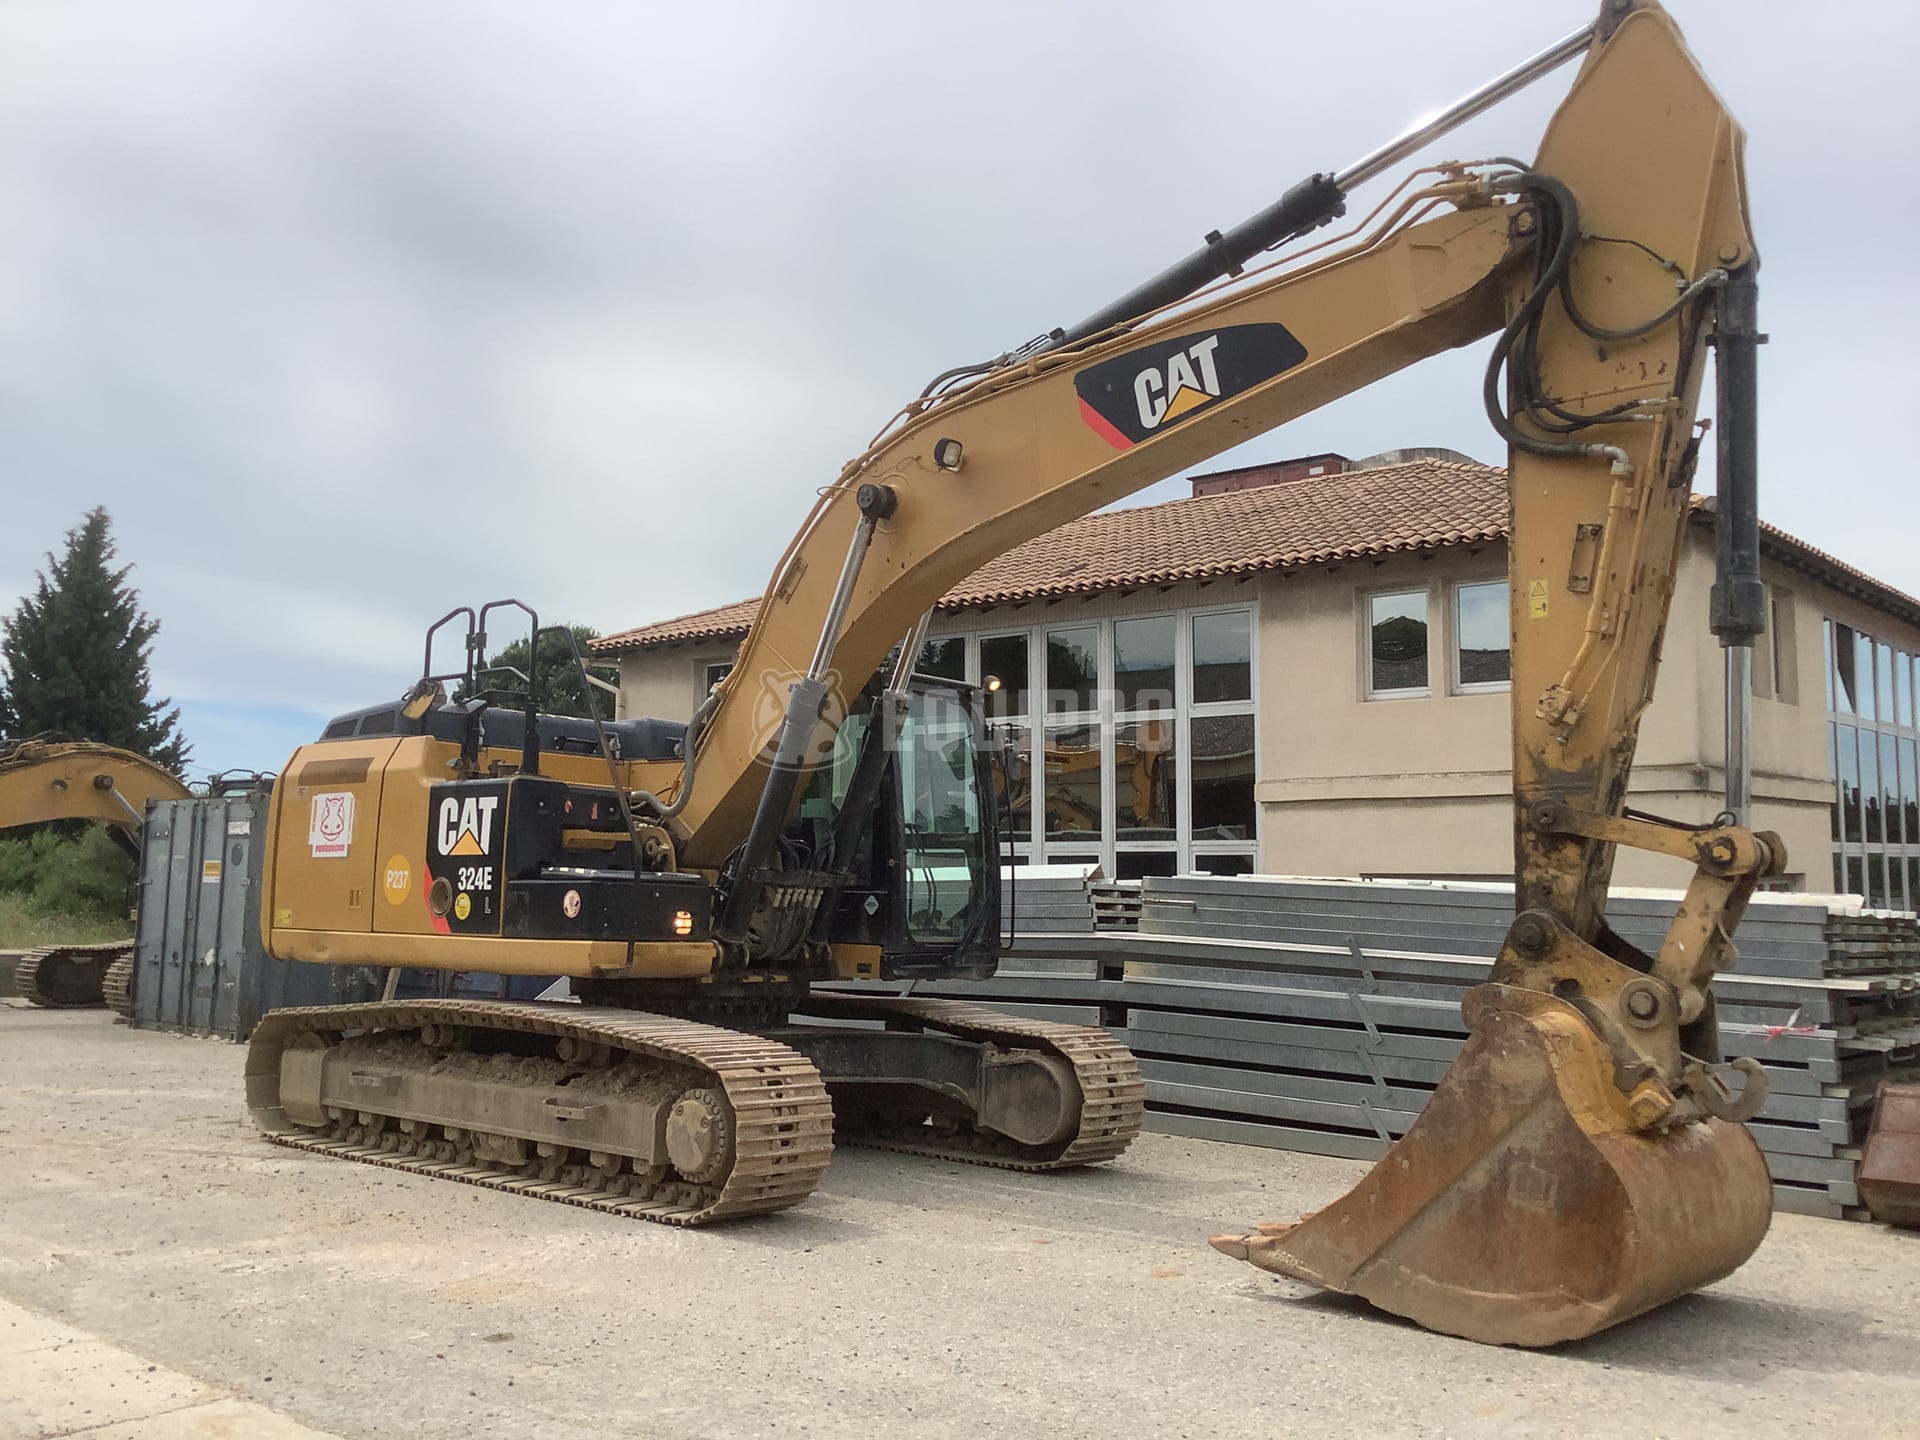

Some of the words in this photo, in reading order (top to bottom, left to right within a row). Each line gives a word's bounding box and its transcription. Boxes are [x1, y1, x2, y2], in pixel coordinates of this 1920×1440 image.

[1133, 334, 1221, 430] CAT
[438, 796, 498, 856] CAT
[386, 870, 409, 889] P237
[458, 866, 492, 891] 324E
[484, 896, 491, 914] L
